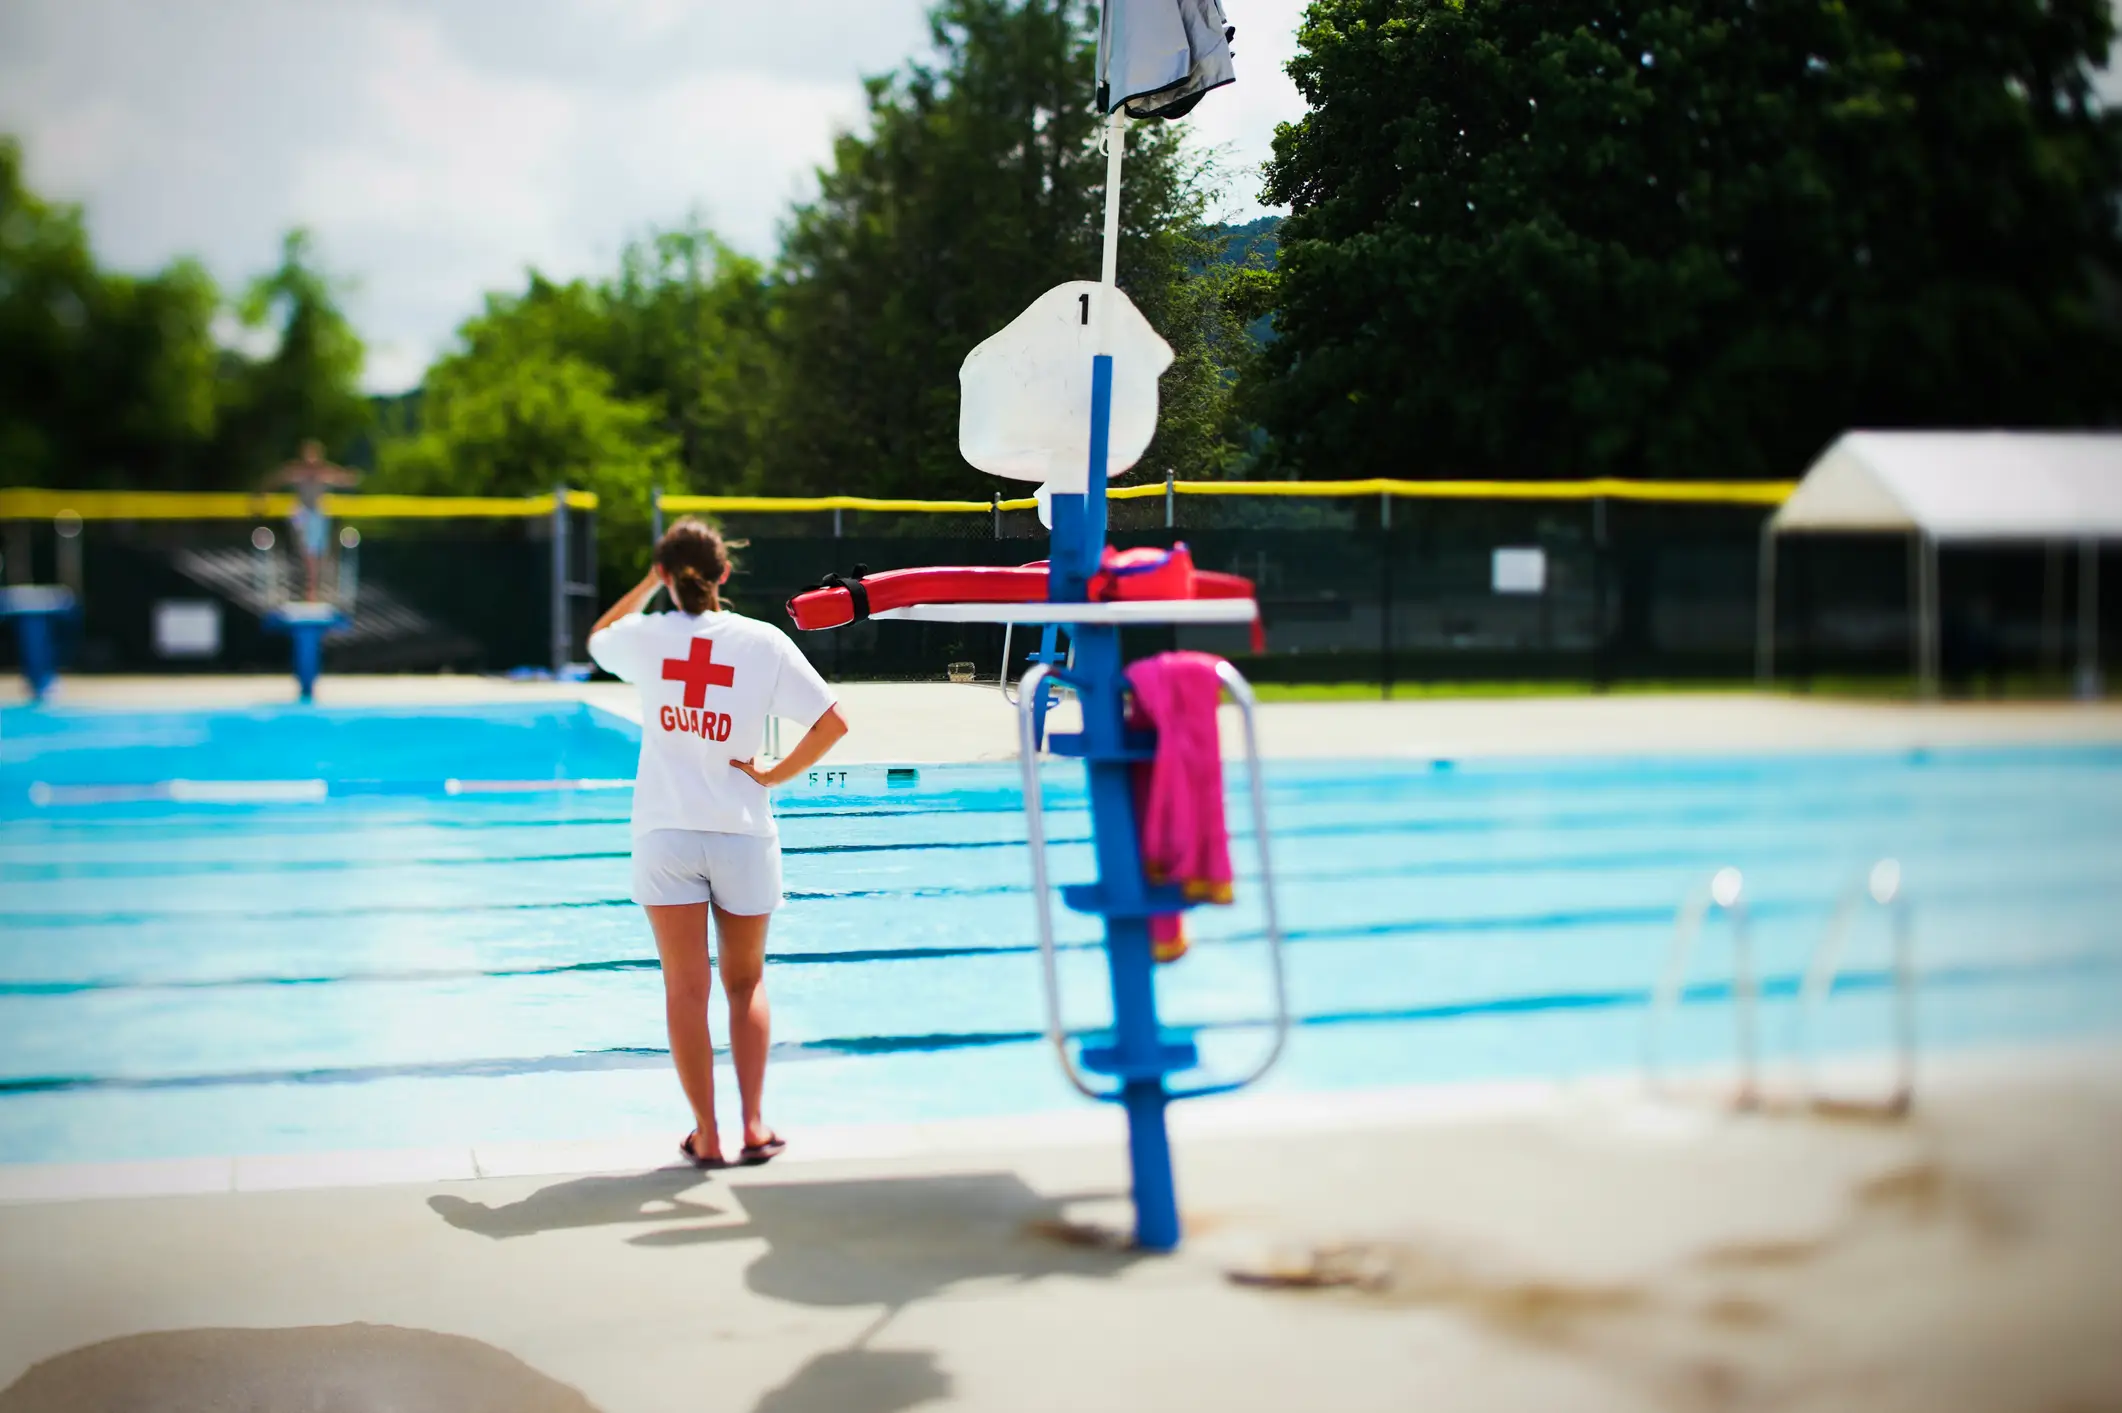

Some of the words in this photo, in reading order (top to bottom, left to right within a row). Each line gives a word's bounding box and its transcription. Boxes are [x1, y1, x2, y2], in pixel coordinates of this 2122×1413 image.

[1078, 293, 1090, 325] 1
[660, 704, 732, 742] GUARD
[826, 771, 848, 787] FT
